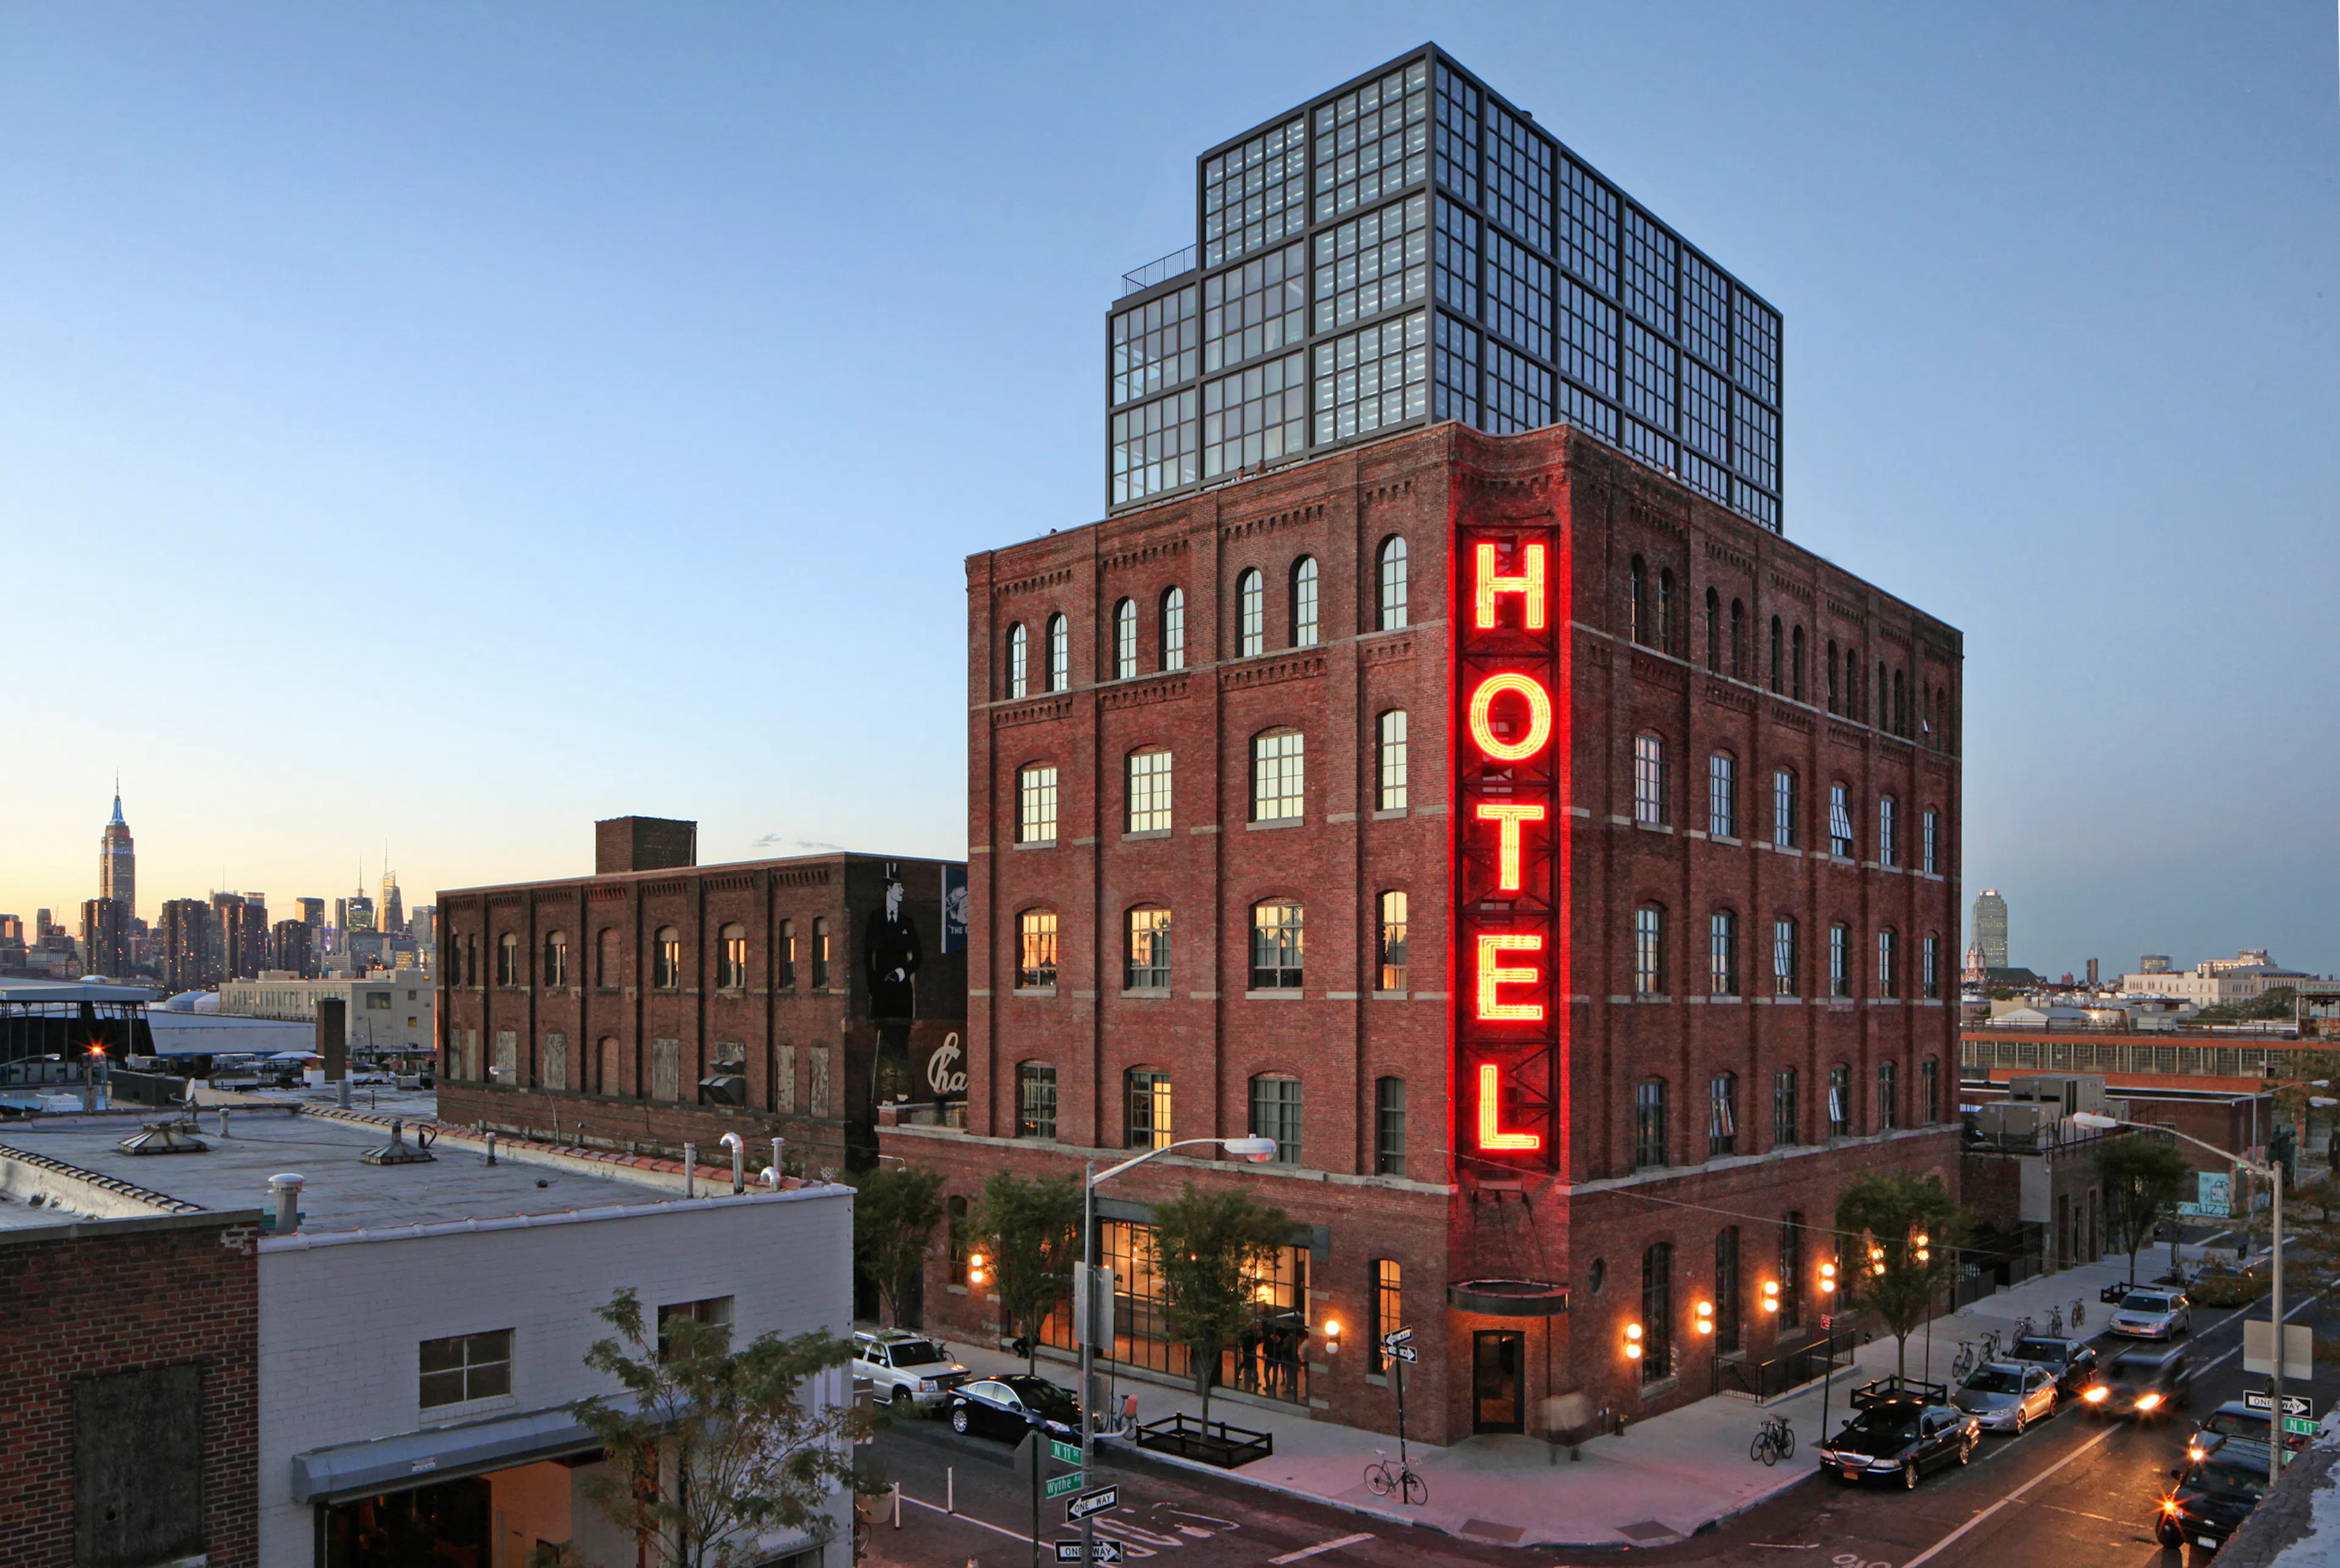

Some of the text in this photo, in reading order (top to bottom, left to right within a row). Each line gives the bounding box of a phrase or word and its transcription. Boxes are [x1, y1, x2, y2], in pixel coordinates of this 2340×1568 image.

[1469, 543, 1551, 1150] HOTEL
[2253, 1398, 2300, 1410] ONE WAY
[2289, 1419, 2313, 1435] N 11
[1054, 1443, 1061, 1457] N
[1063, 1446, 1071, 1461] 11
[1047, 1478, 1071, 1495] Wythe
[1074, 1494, 1112, 1513] ONE WAY
[1065, 1547, 1112, 1556] ONE WAY
